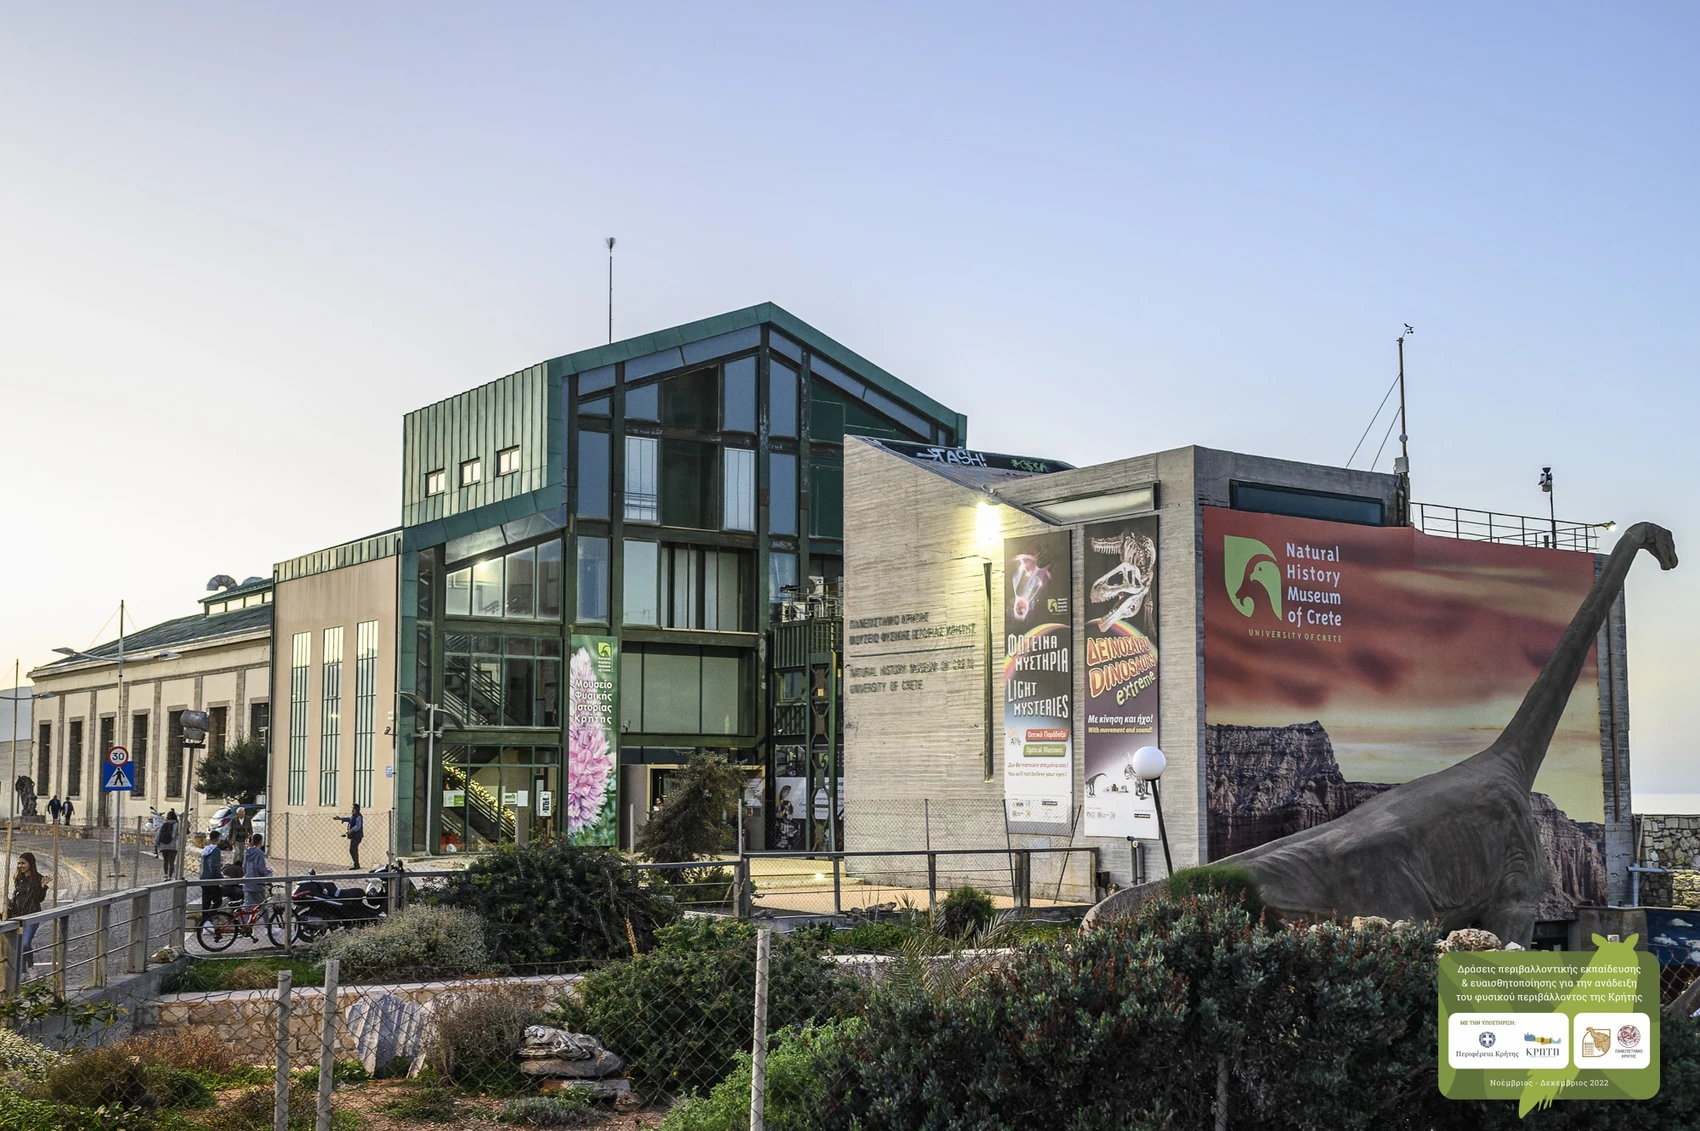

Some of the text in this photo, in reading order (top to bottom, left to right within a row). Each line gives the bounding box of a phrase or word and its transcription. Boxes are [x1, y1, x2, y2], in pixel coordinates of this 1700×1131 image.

[1286, 542, 1340, 562] Natural
[1286, 564, 1341, 588] History
[1287, 586, 1341, 605] Museum
[1288, 606, 1342, 628] of Crete
[1007, 633, 1058, 658] ΦΩΤΕΙΝΑ
[1248, 629, 1342, 643] UNIVERSITY OF CRETE
[1015, 647, 1069, 673] ΜΥΣΤΗΡΙΑ
[575, 679, 613, 689] Μουσείο
[849, 679, 924, 694] UNIVERSITY OF CRETE
[1007, 678, 1038, 703] LIGHT
[1116, 671, 1156, 706] extreme
[574, 691, 612, 702] Φυσικής
[575, 702, 612, 713] Ιστορίας
[1013, 694, 1069, 719] MYSTERIES
[574, 713, 612, 725] Κρήτης
[1088, 714, 1153, 726] Με κίνηση και ήχο!
[112, 752, 125, 761] 30
